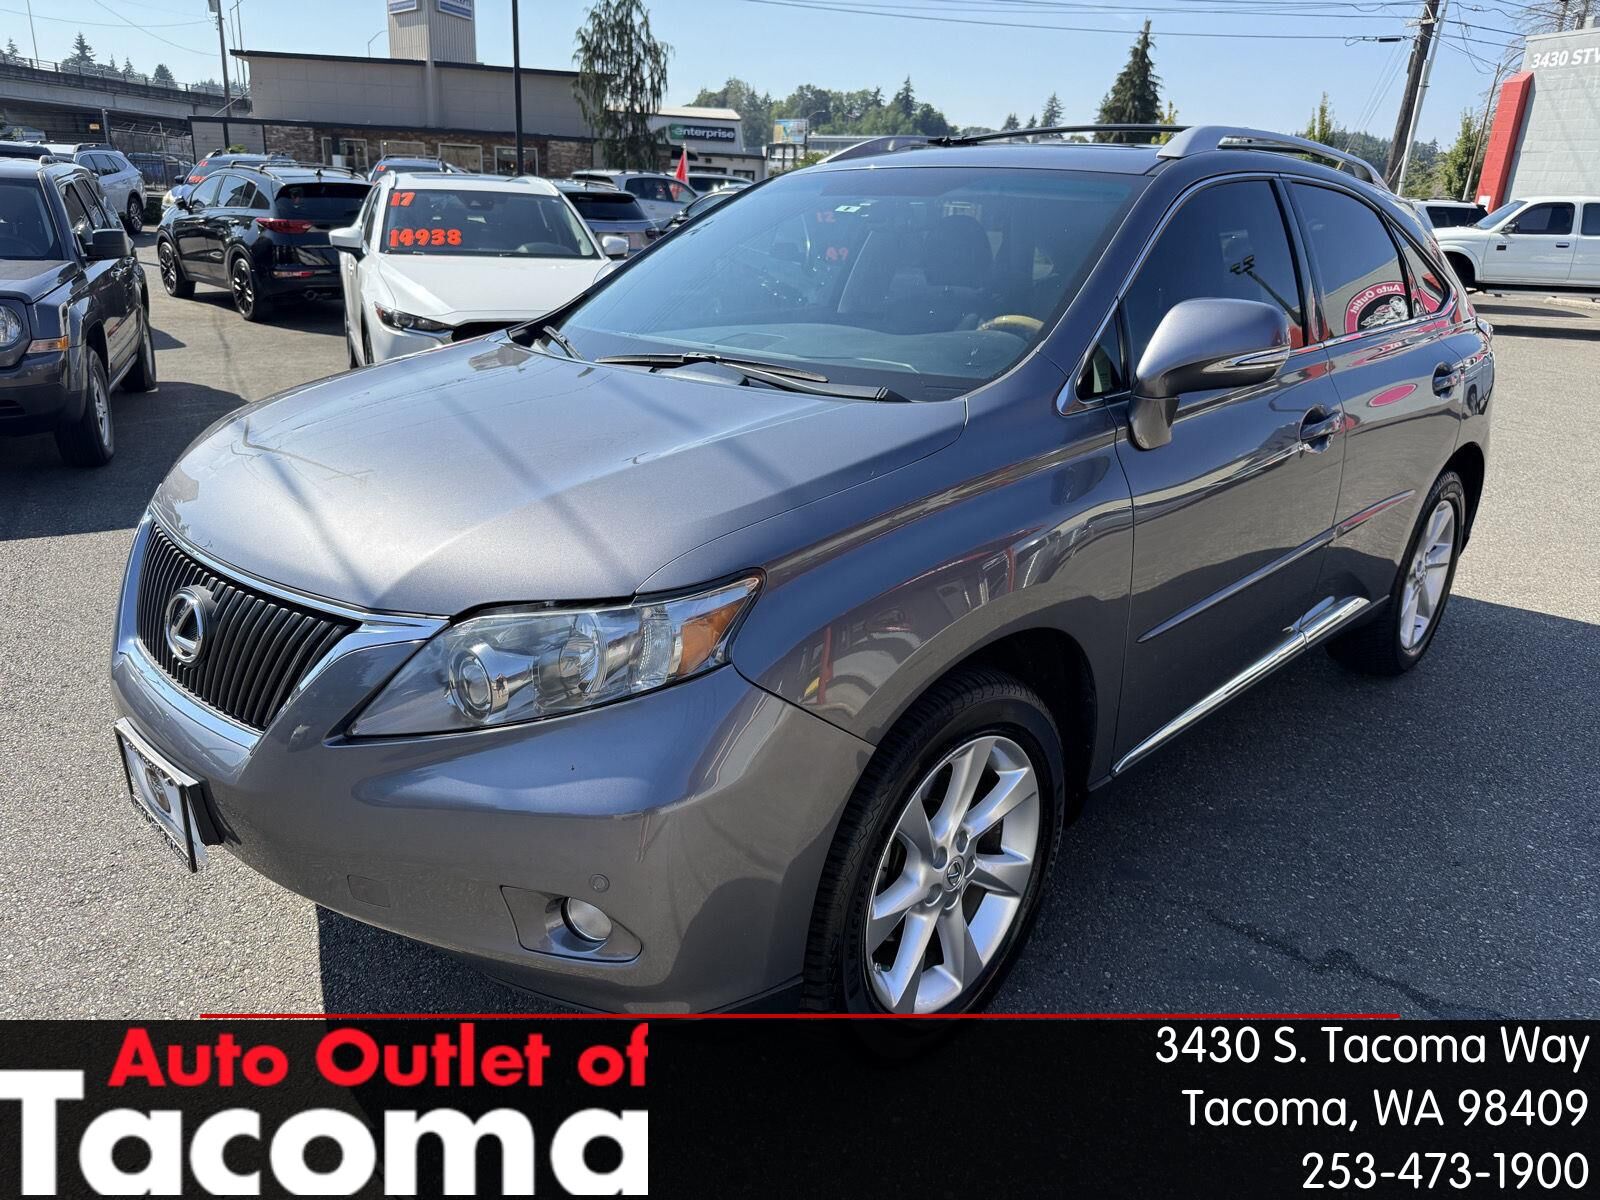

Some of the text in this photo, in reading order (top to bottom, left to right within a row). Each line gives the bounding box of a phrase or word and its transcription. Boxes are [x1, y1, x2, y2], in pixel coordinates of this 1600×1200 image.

[1530, 50, 1569, 69] 3430
[674, 125, 735, 140] enterprise
[390, 191, 416, 208] 17
[389, 227, 462, 248] 14938
